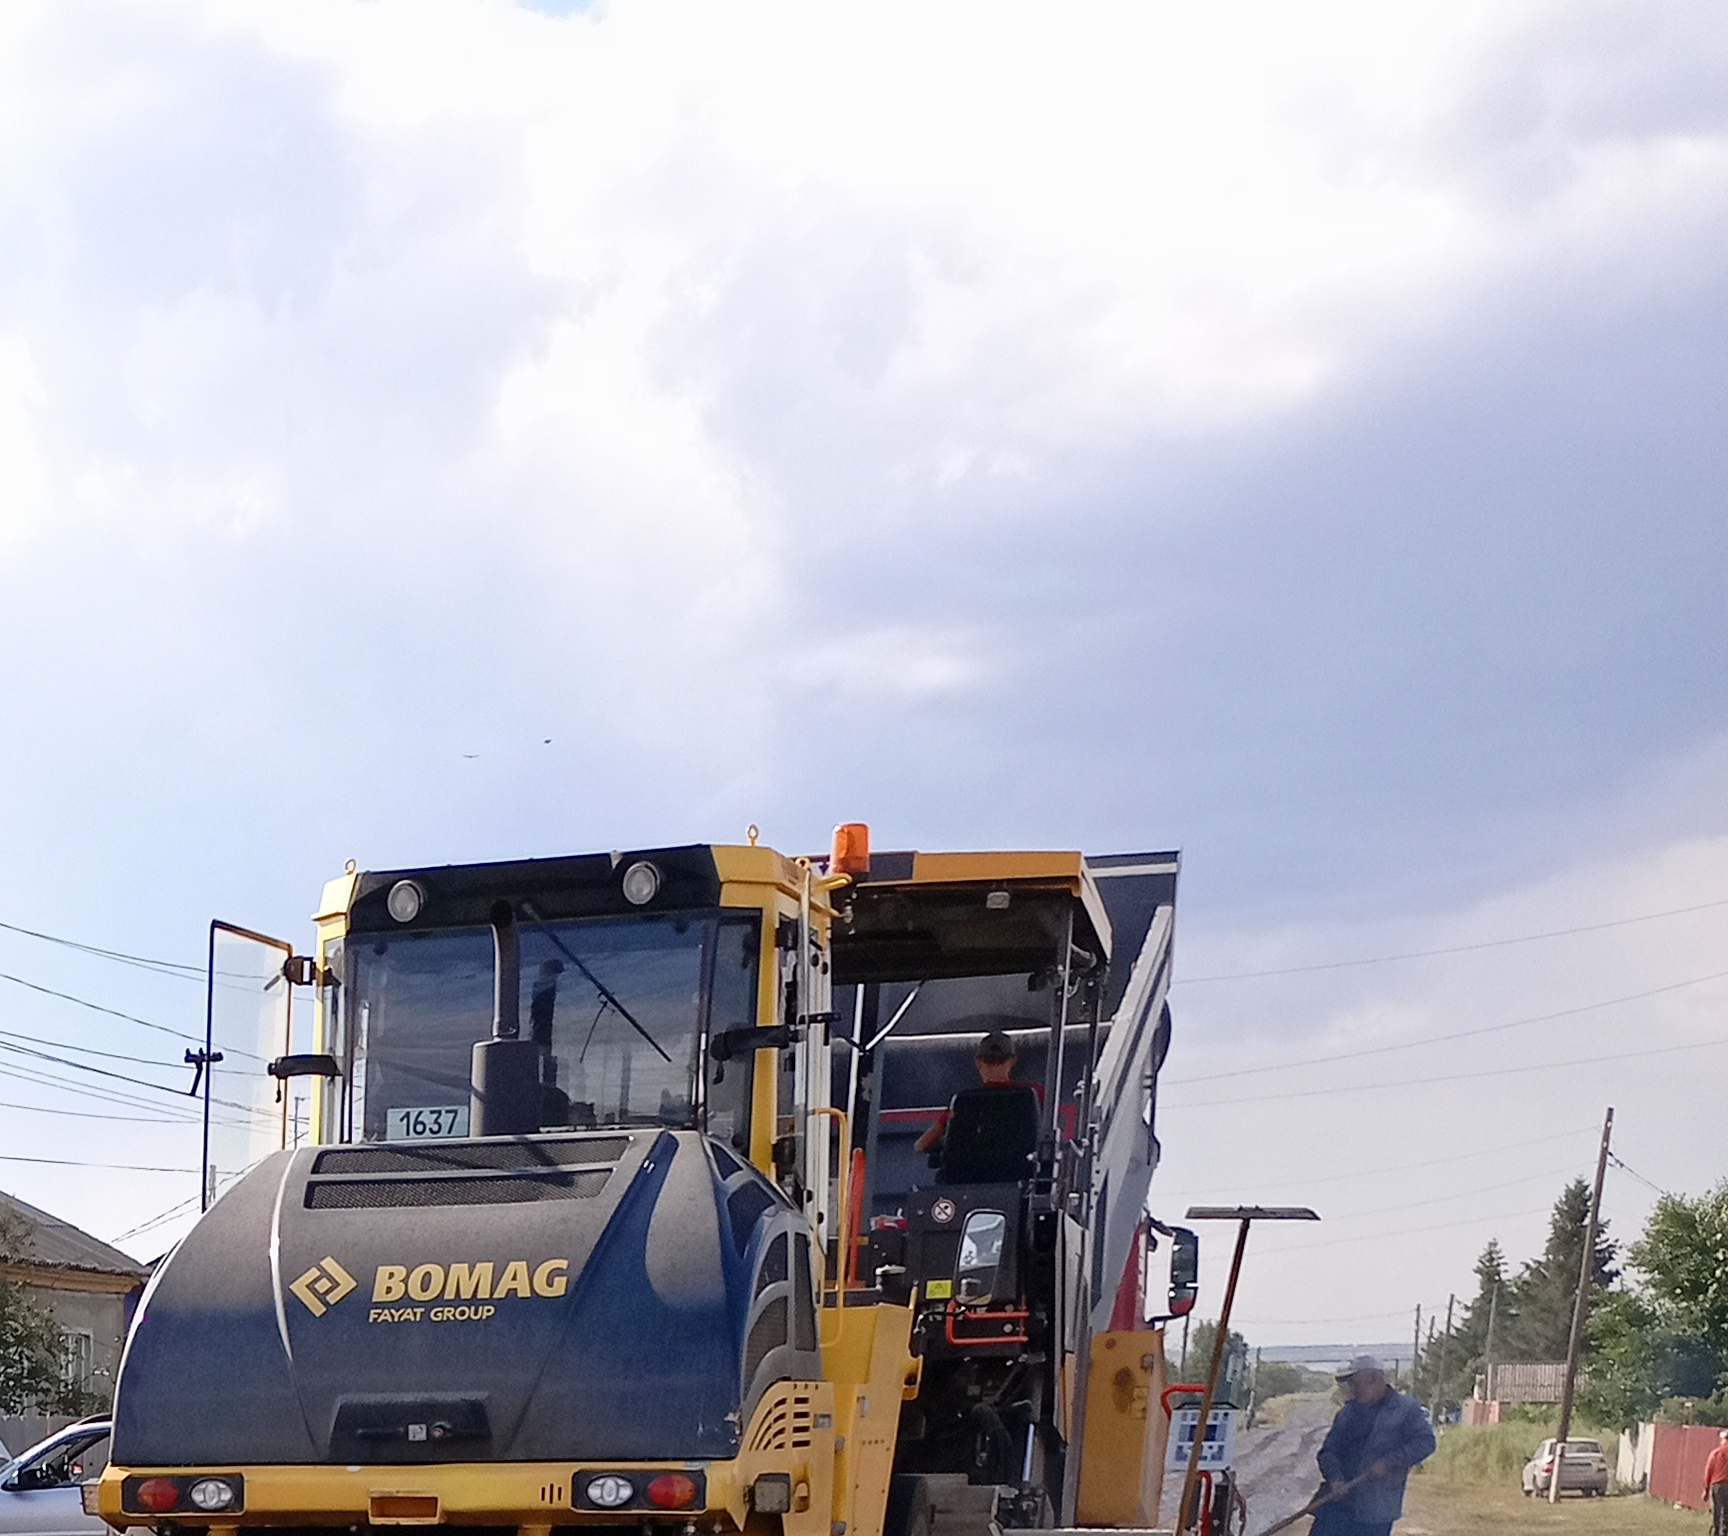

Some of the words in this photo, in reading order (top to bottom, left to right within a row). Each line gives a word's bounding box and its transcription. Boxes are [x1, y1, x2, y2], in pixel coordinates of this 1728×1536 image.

[399, 1109, 459, 1136] 1637
[372, 1258, 569, 1302] BOMAG
[369, 1307, 425, 1322] FAYAT
[429, 1305, 496, 1321] GROUP
